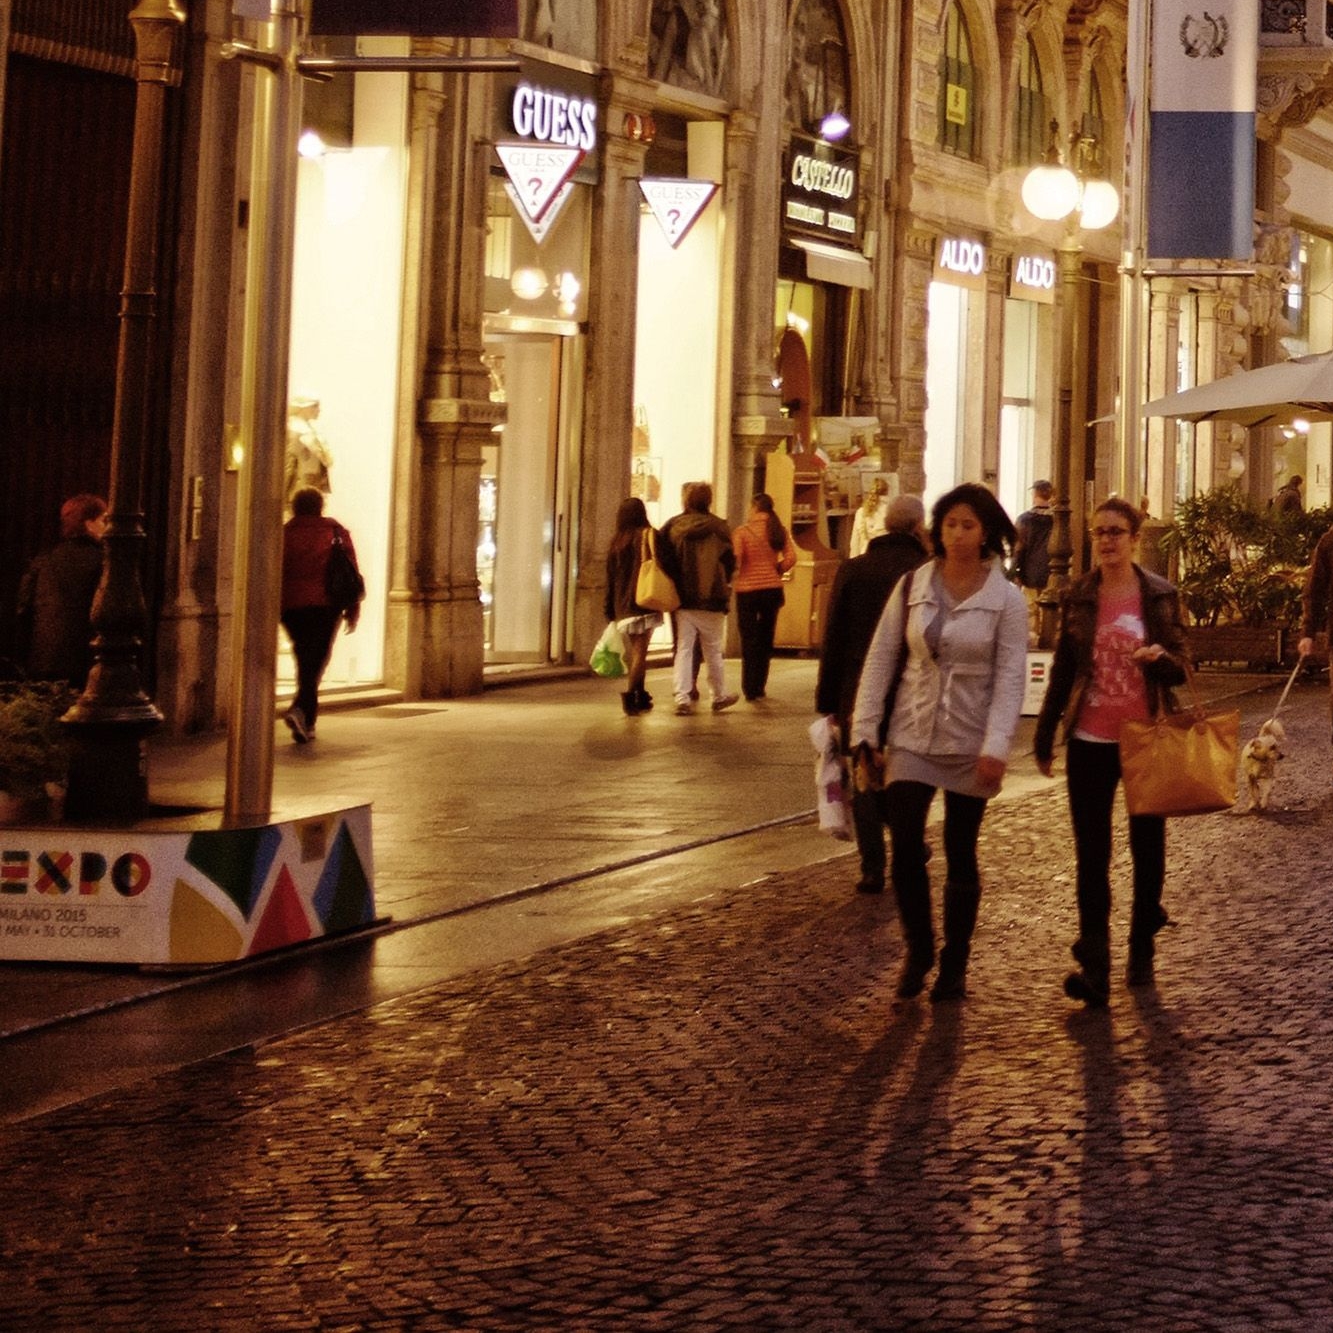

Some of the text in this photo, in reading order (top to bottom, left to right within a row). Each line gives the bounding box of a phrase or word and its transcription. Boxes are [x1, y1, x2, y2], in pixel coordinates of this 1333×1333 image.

[513, 86, 597, 150] GUESS
[508, 151, 567, 167] GUESS
[649, 185, 703, 200] GUESS
[791, 154, 854, 200] CASTELLO
[940, 239, 984, 276] ALDO
[1015, 256, 1054, 290] ALDO
[0, 850, 152, 898] EXPO
[55, 908, 87, 922] 2015
[59, 925, 121, 938] OCTOBER
